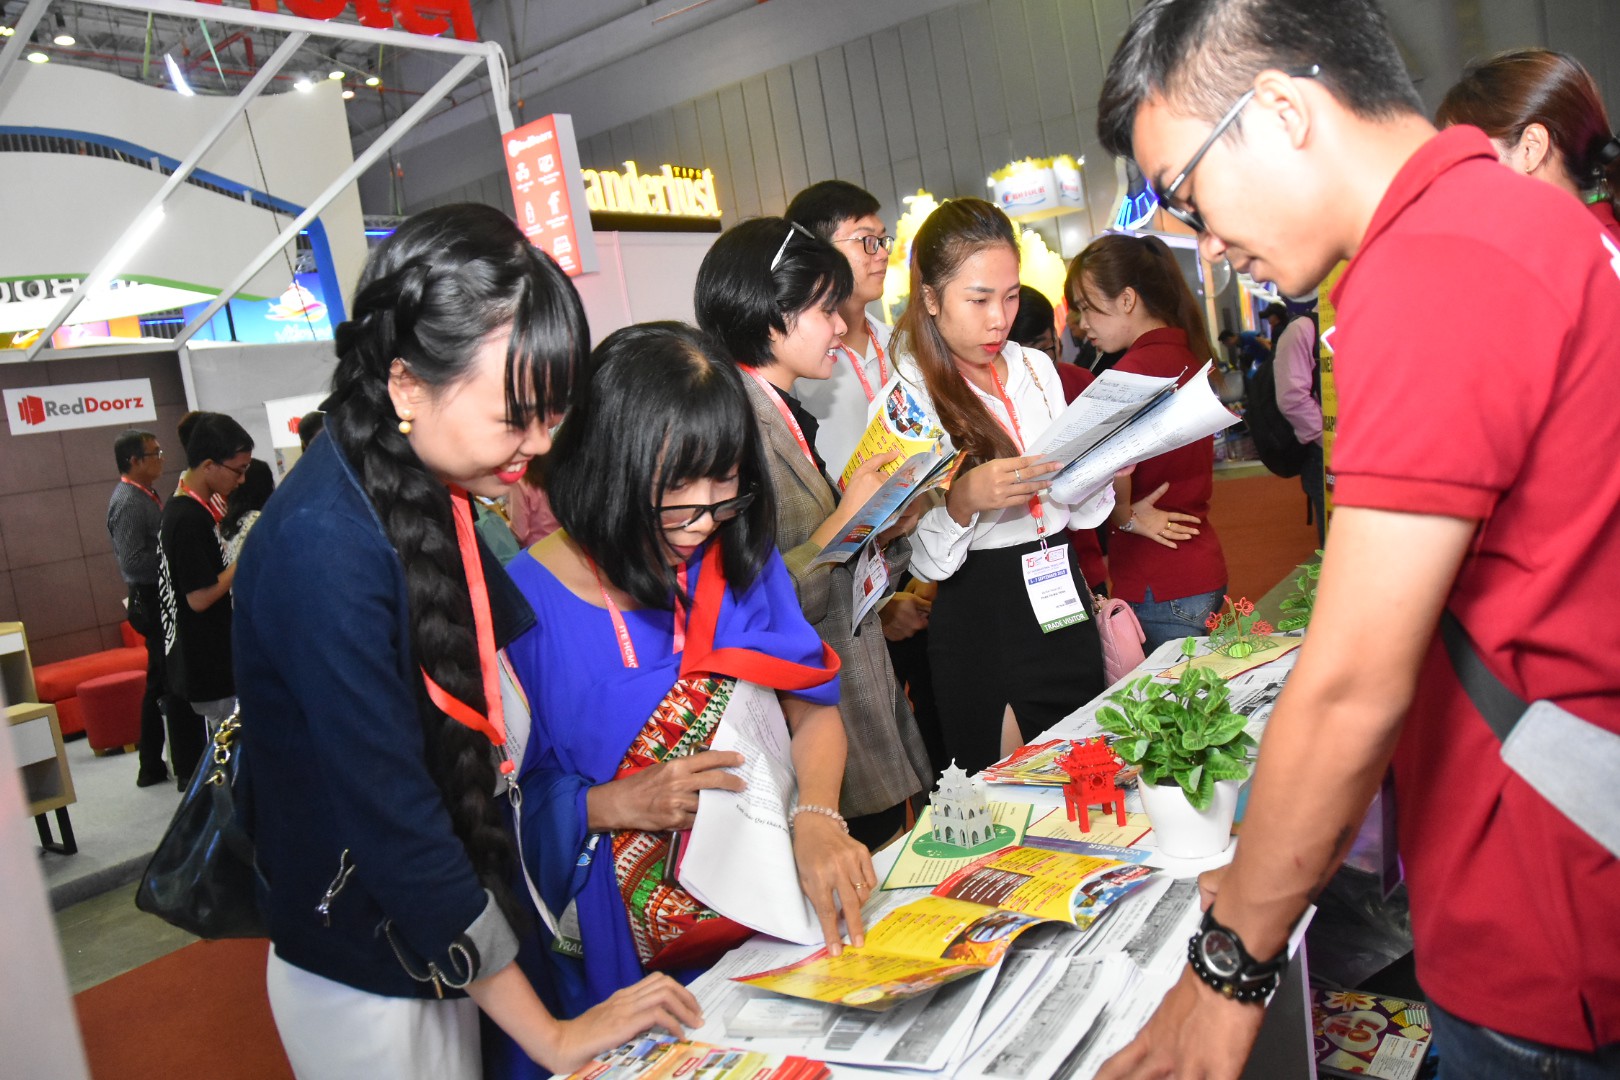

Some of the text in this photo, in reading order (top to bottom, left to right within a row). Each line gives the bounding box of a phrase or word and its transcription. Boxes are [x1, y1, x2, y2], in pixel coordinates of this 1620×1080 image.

[673, 166, 702, 178] TIPS
[580, 160, 722, 217] anderlust
[45, 397, 144, 417] RedDoorz
[1045, 620, 1063, 631] TRADE
[619, 625, 628, 641] ITE
[1088, 843, 1141, 856] VOUCHER
